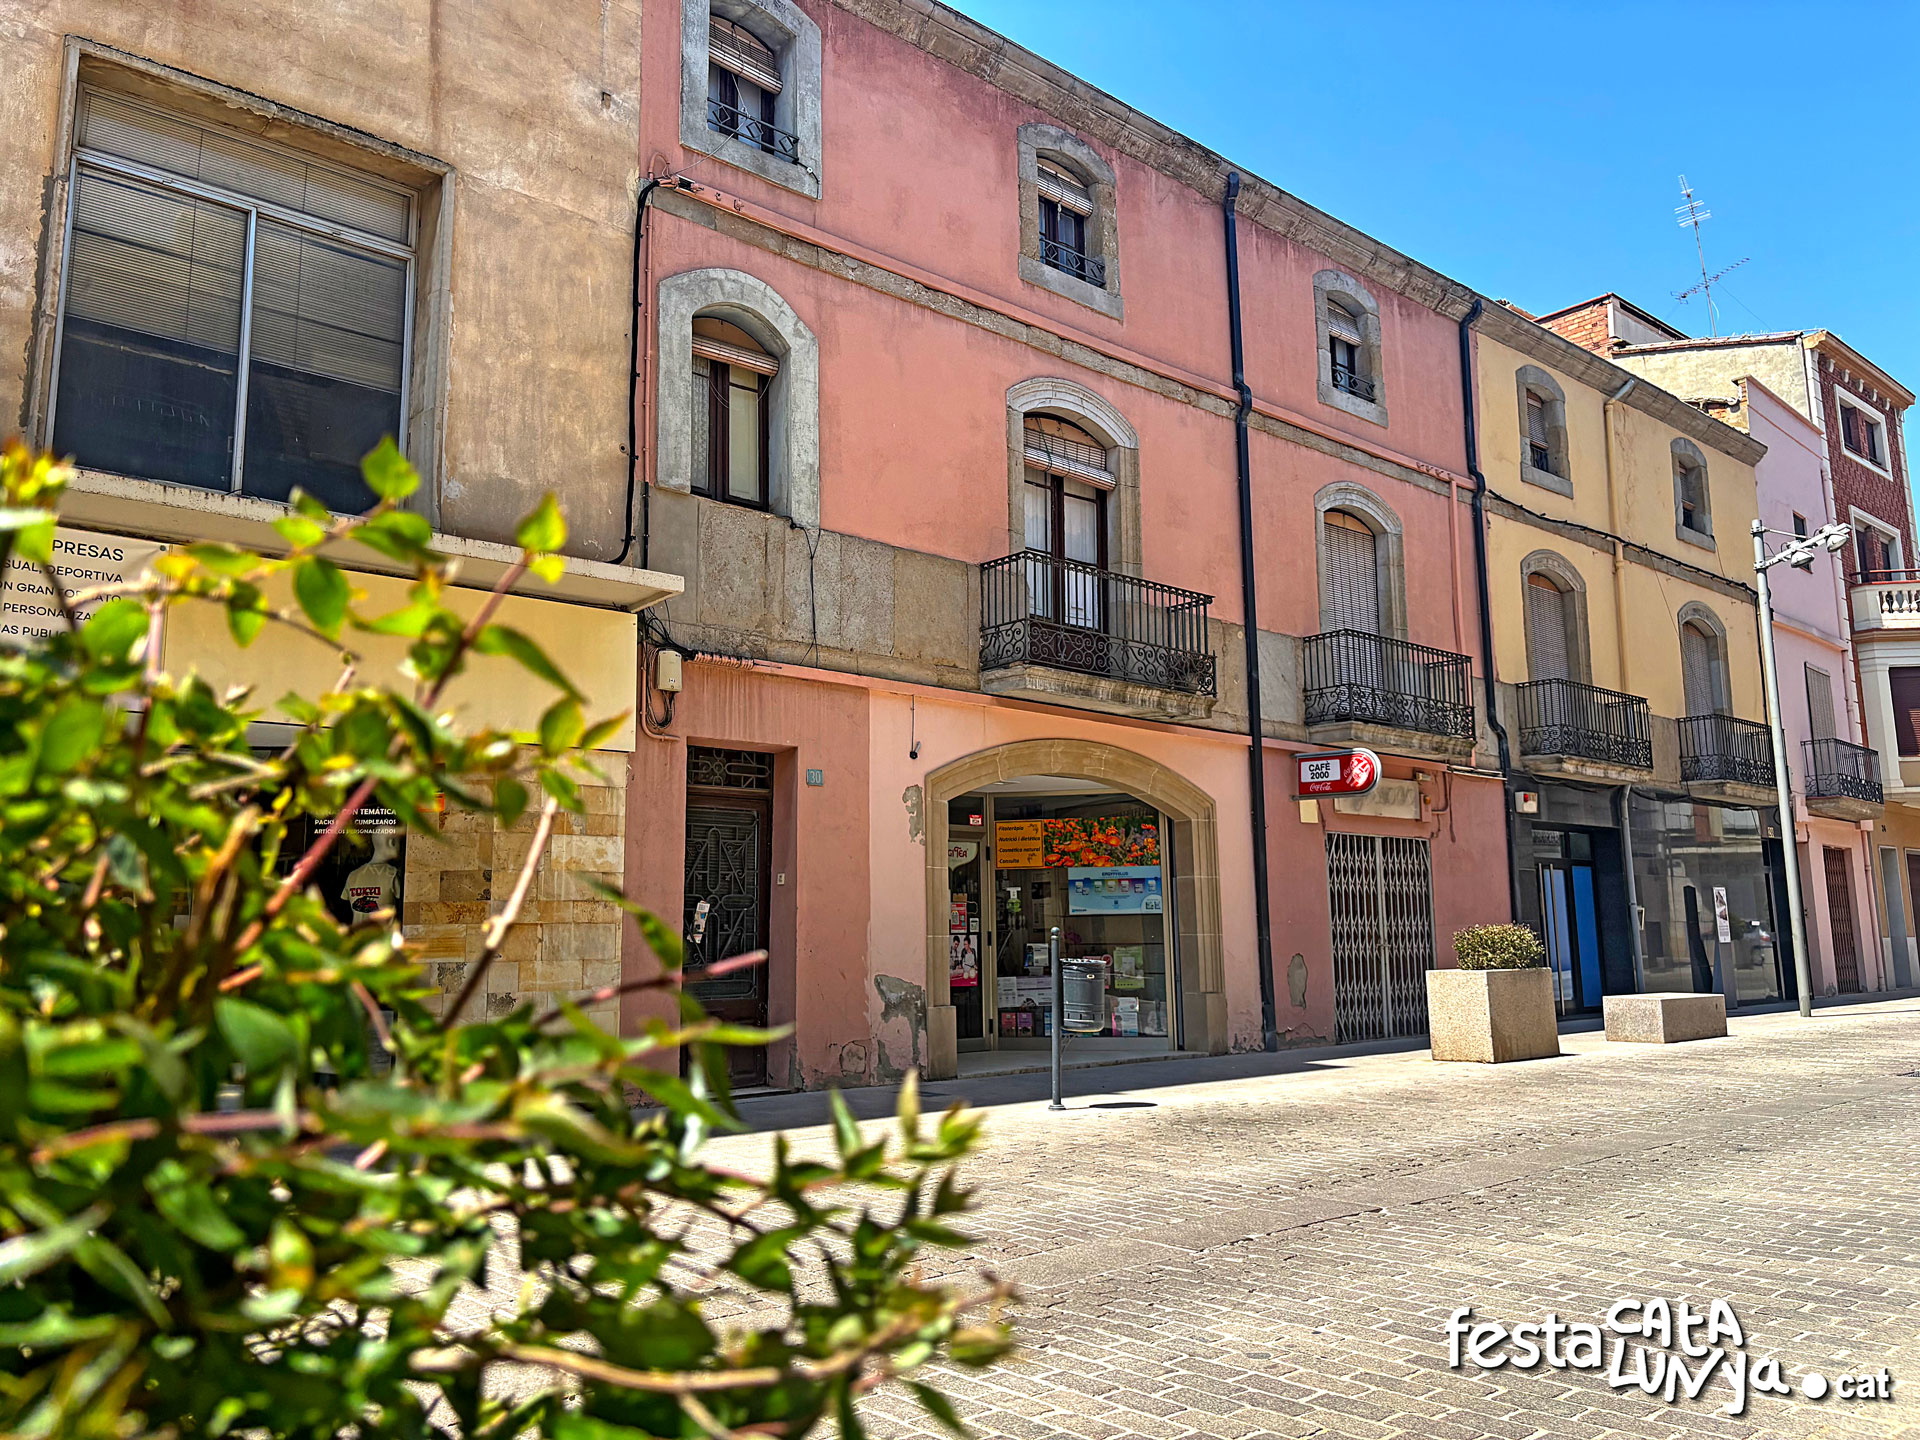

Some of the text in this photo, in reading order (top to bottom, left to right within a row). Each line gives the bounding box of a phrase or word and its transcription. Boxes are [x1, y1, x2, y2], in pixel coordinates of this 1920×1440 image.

[52, 539, 124, 561] PRESAS
[4, 559, 123, 583] SUAL, DEPORTIVA
[17, 582, 55, 596] GRAN
[809, 770, 821, 784] 30
[1310, 771, 1330, 780] 2000
[360, 806, 397, 815] TEMÁTICA
[350, 886, 381, 897] TOKYO
